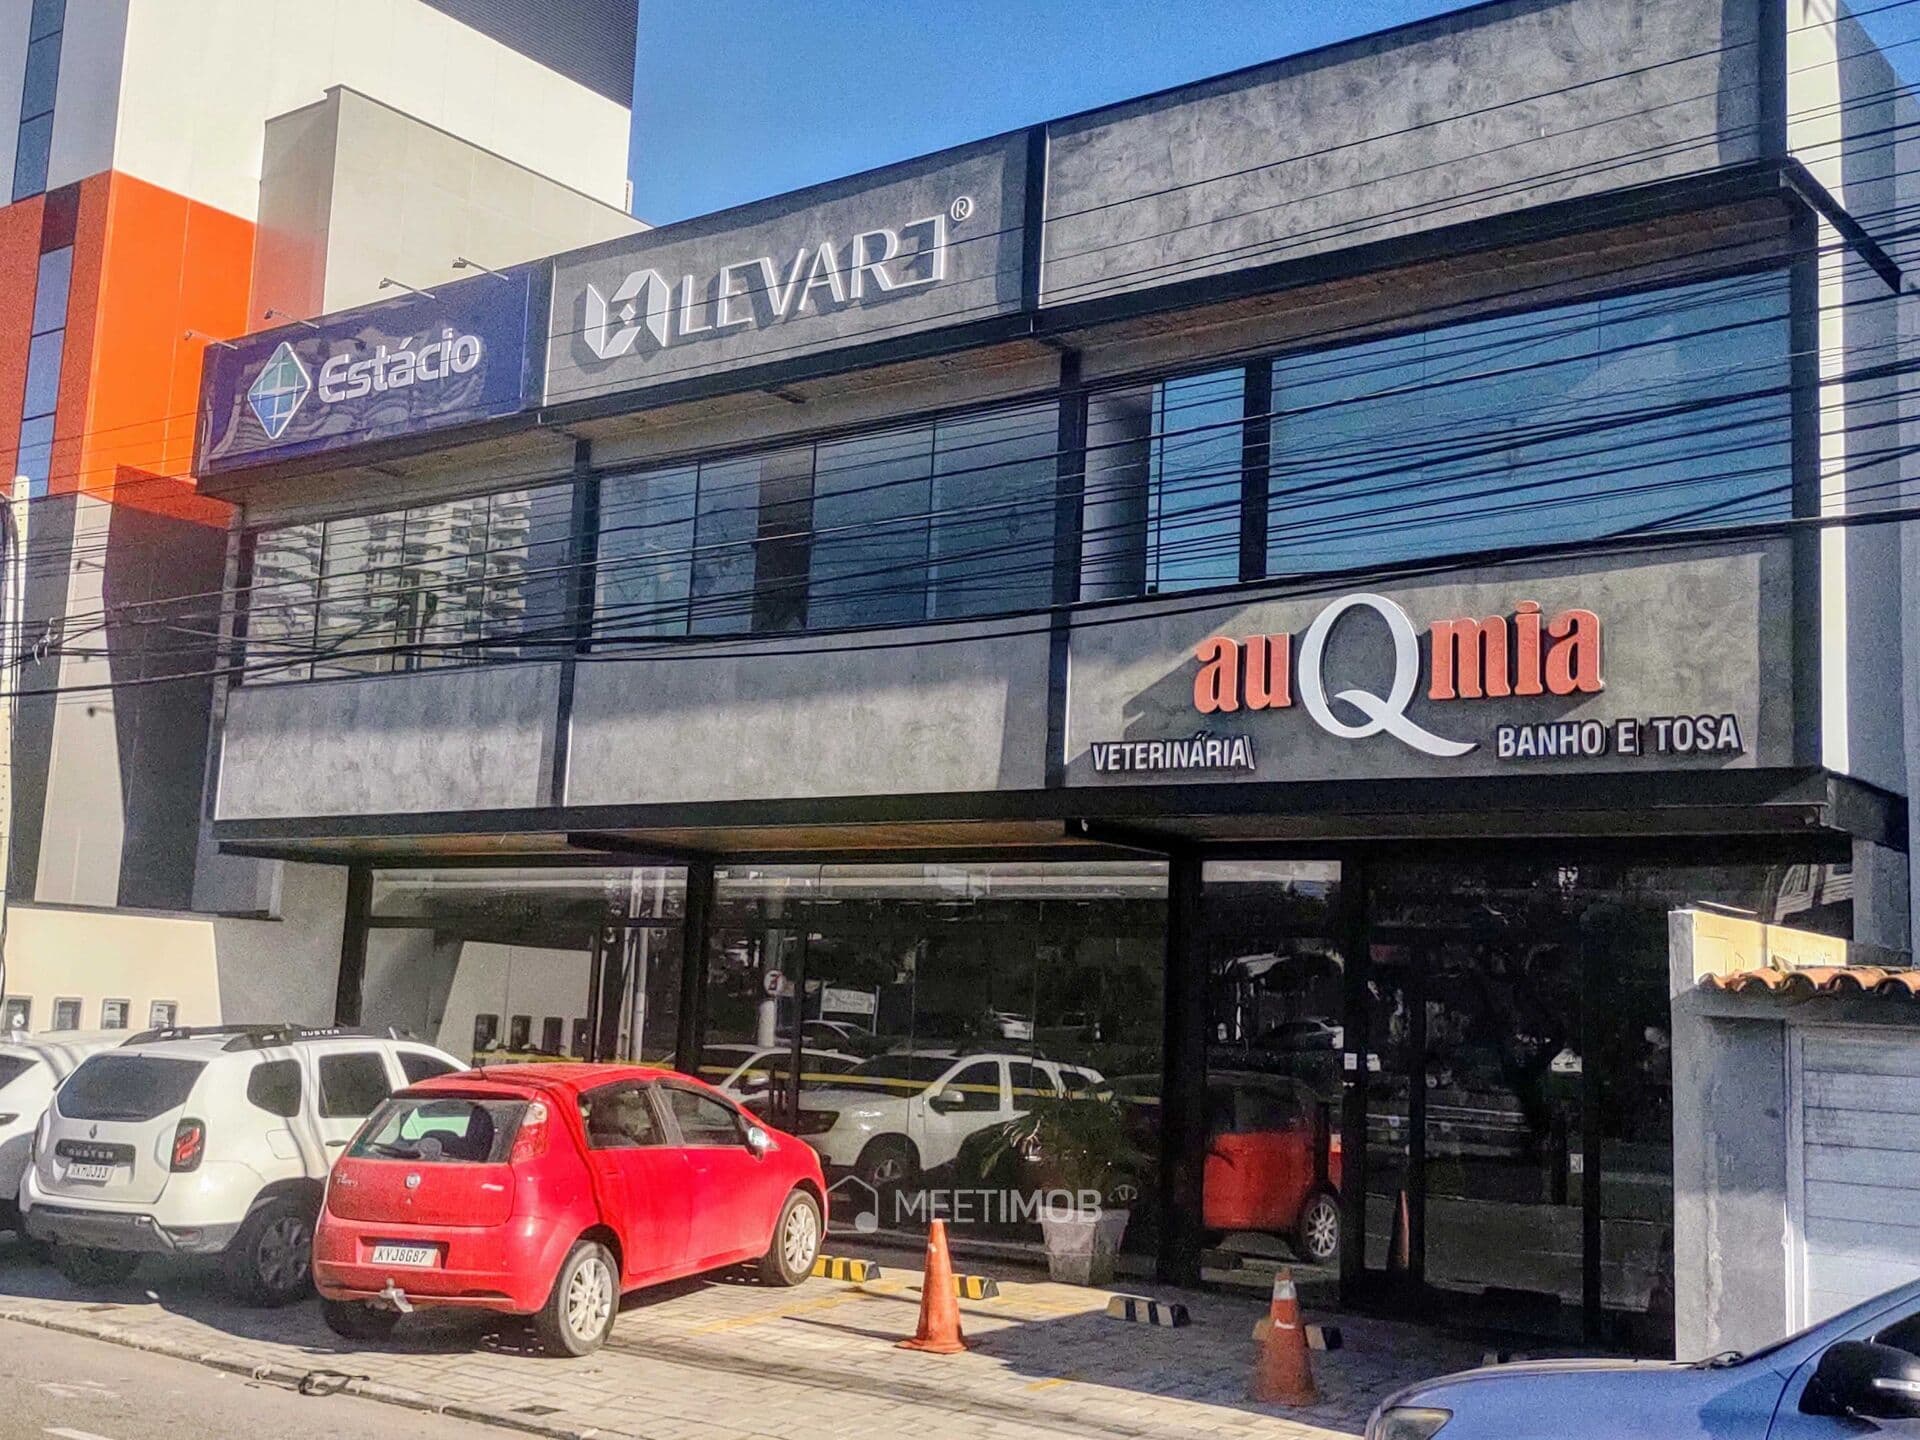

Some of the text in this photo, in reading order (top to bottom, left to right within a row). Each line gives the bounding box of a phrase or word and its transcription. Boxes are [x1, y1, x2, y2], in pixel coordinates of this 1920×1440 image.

[318, 327, 480, 404] Estácio
[1193, 593, 1607, 758] auQmia
[1092, 732, 1255, 771] VETERINÁRIA
[1497, 716, 1745, 758] BANHO E TOSA
